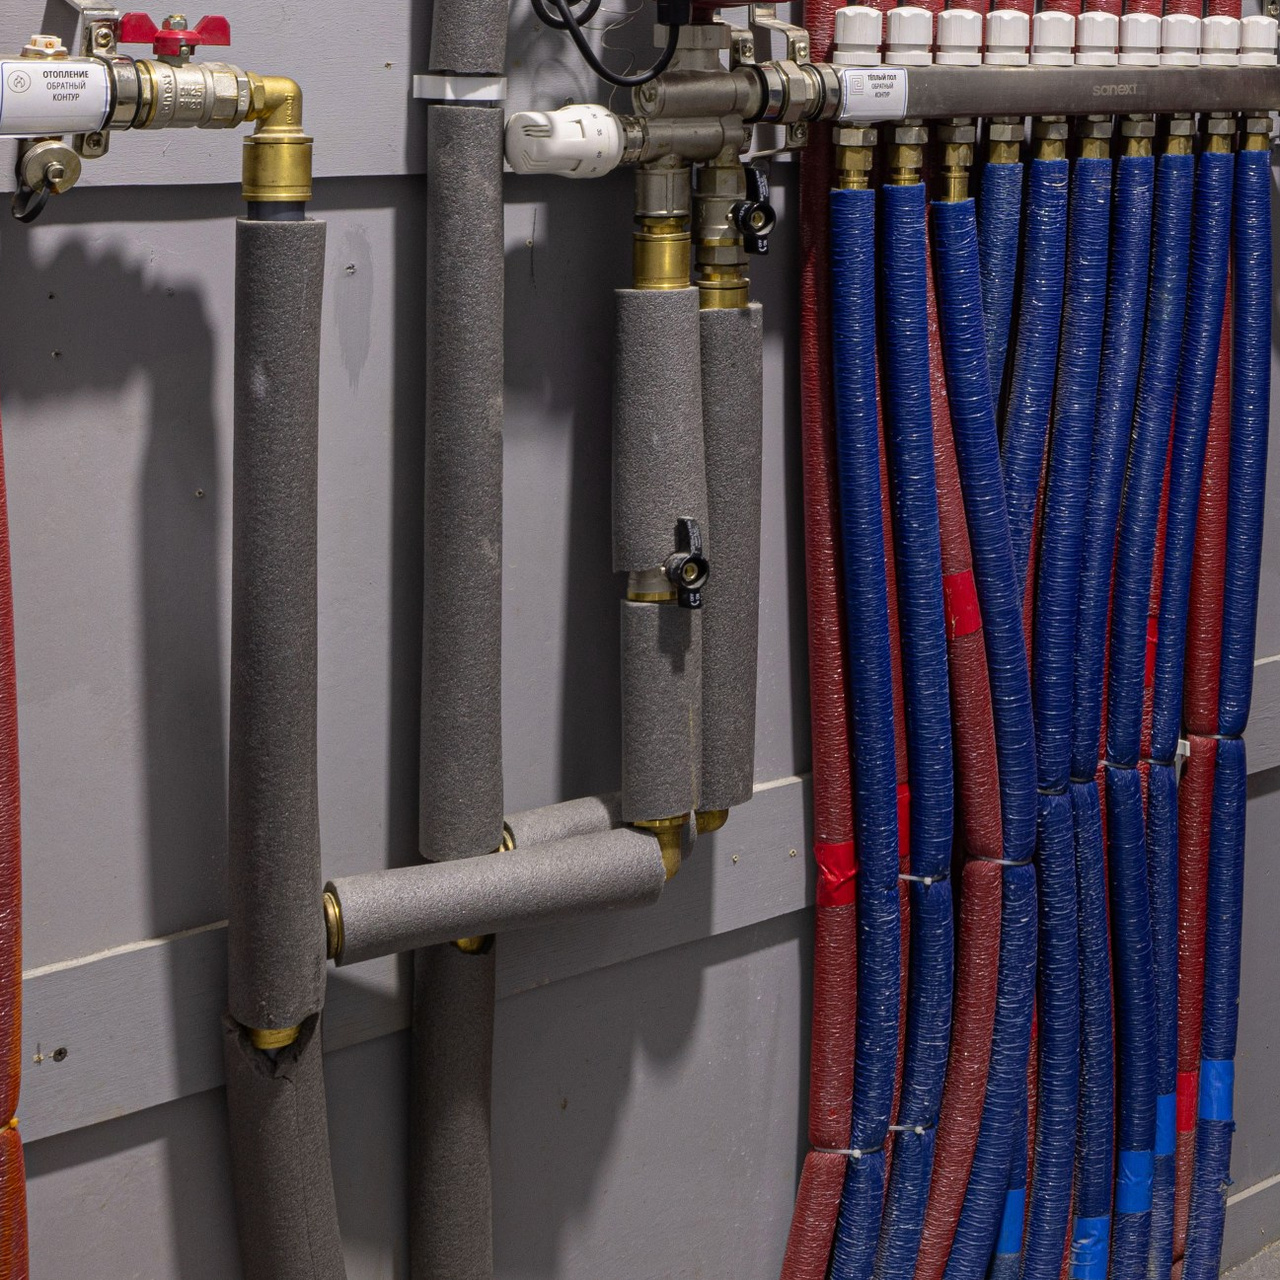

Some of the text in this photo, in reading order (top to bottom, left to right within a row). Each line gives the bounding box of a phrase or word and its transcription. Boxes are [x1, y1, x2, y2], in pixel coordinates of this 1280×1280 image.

[43, 70, 89, 79] ОТОПЛЕНИЕ
[46, 80, 86, 90] ОБРАТНЫЙ
[1092, 83, 1138, 96] sanext
[52, 93, 80, 102] КОНТУР
[597, 128, 602, 136] 35
